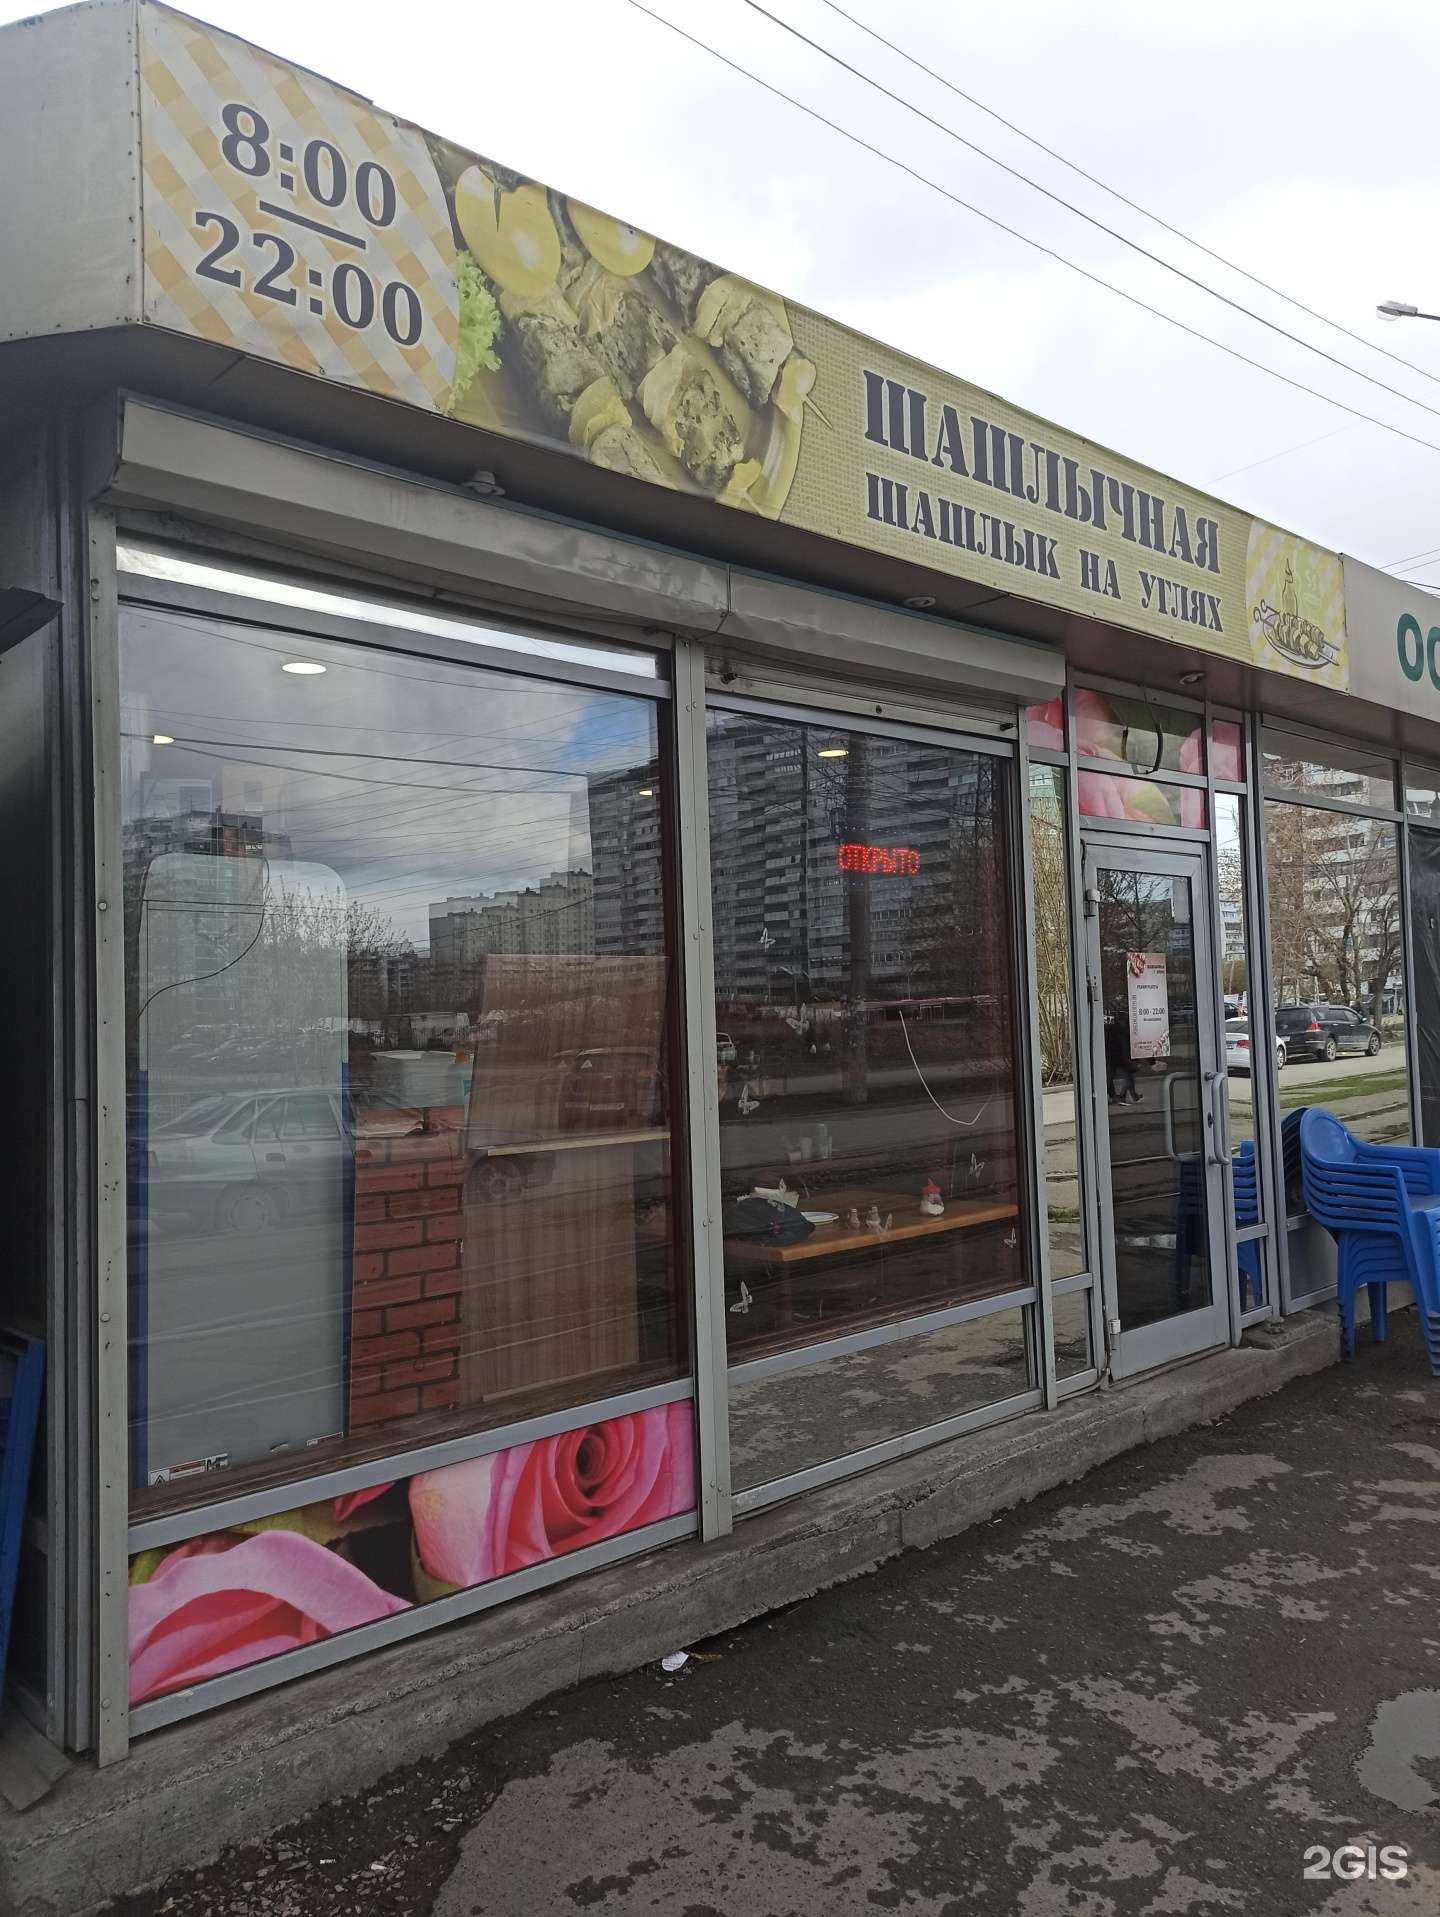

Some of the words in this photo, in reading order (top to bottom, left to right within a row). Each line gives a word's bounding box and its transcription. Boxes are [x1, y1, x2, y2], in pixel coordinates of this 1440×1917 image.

[222, 103, 397, 228] 8:00
[195, 211, 423, 346] 22:00
[863, 369, 1221, 574] ШАШЛЫЧНАЯ
[866, 472, 1061, 580] ШАШЛЫК
[1079, 549, 1122, 600] НА
[1138, 570, 1224, 633] УГЛЯХ
[838, 844, 921, 875] ОТКРЫТО
